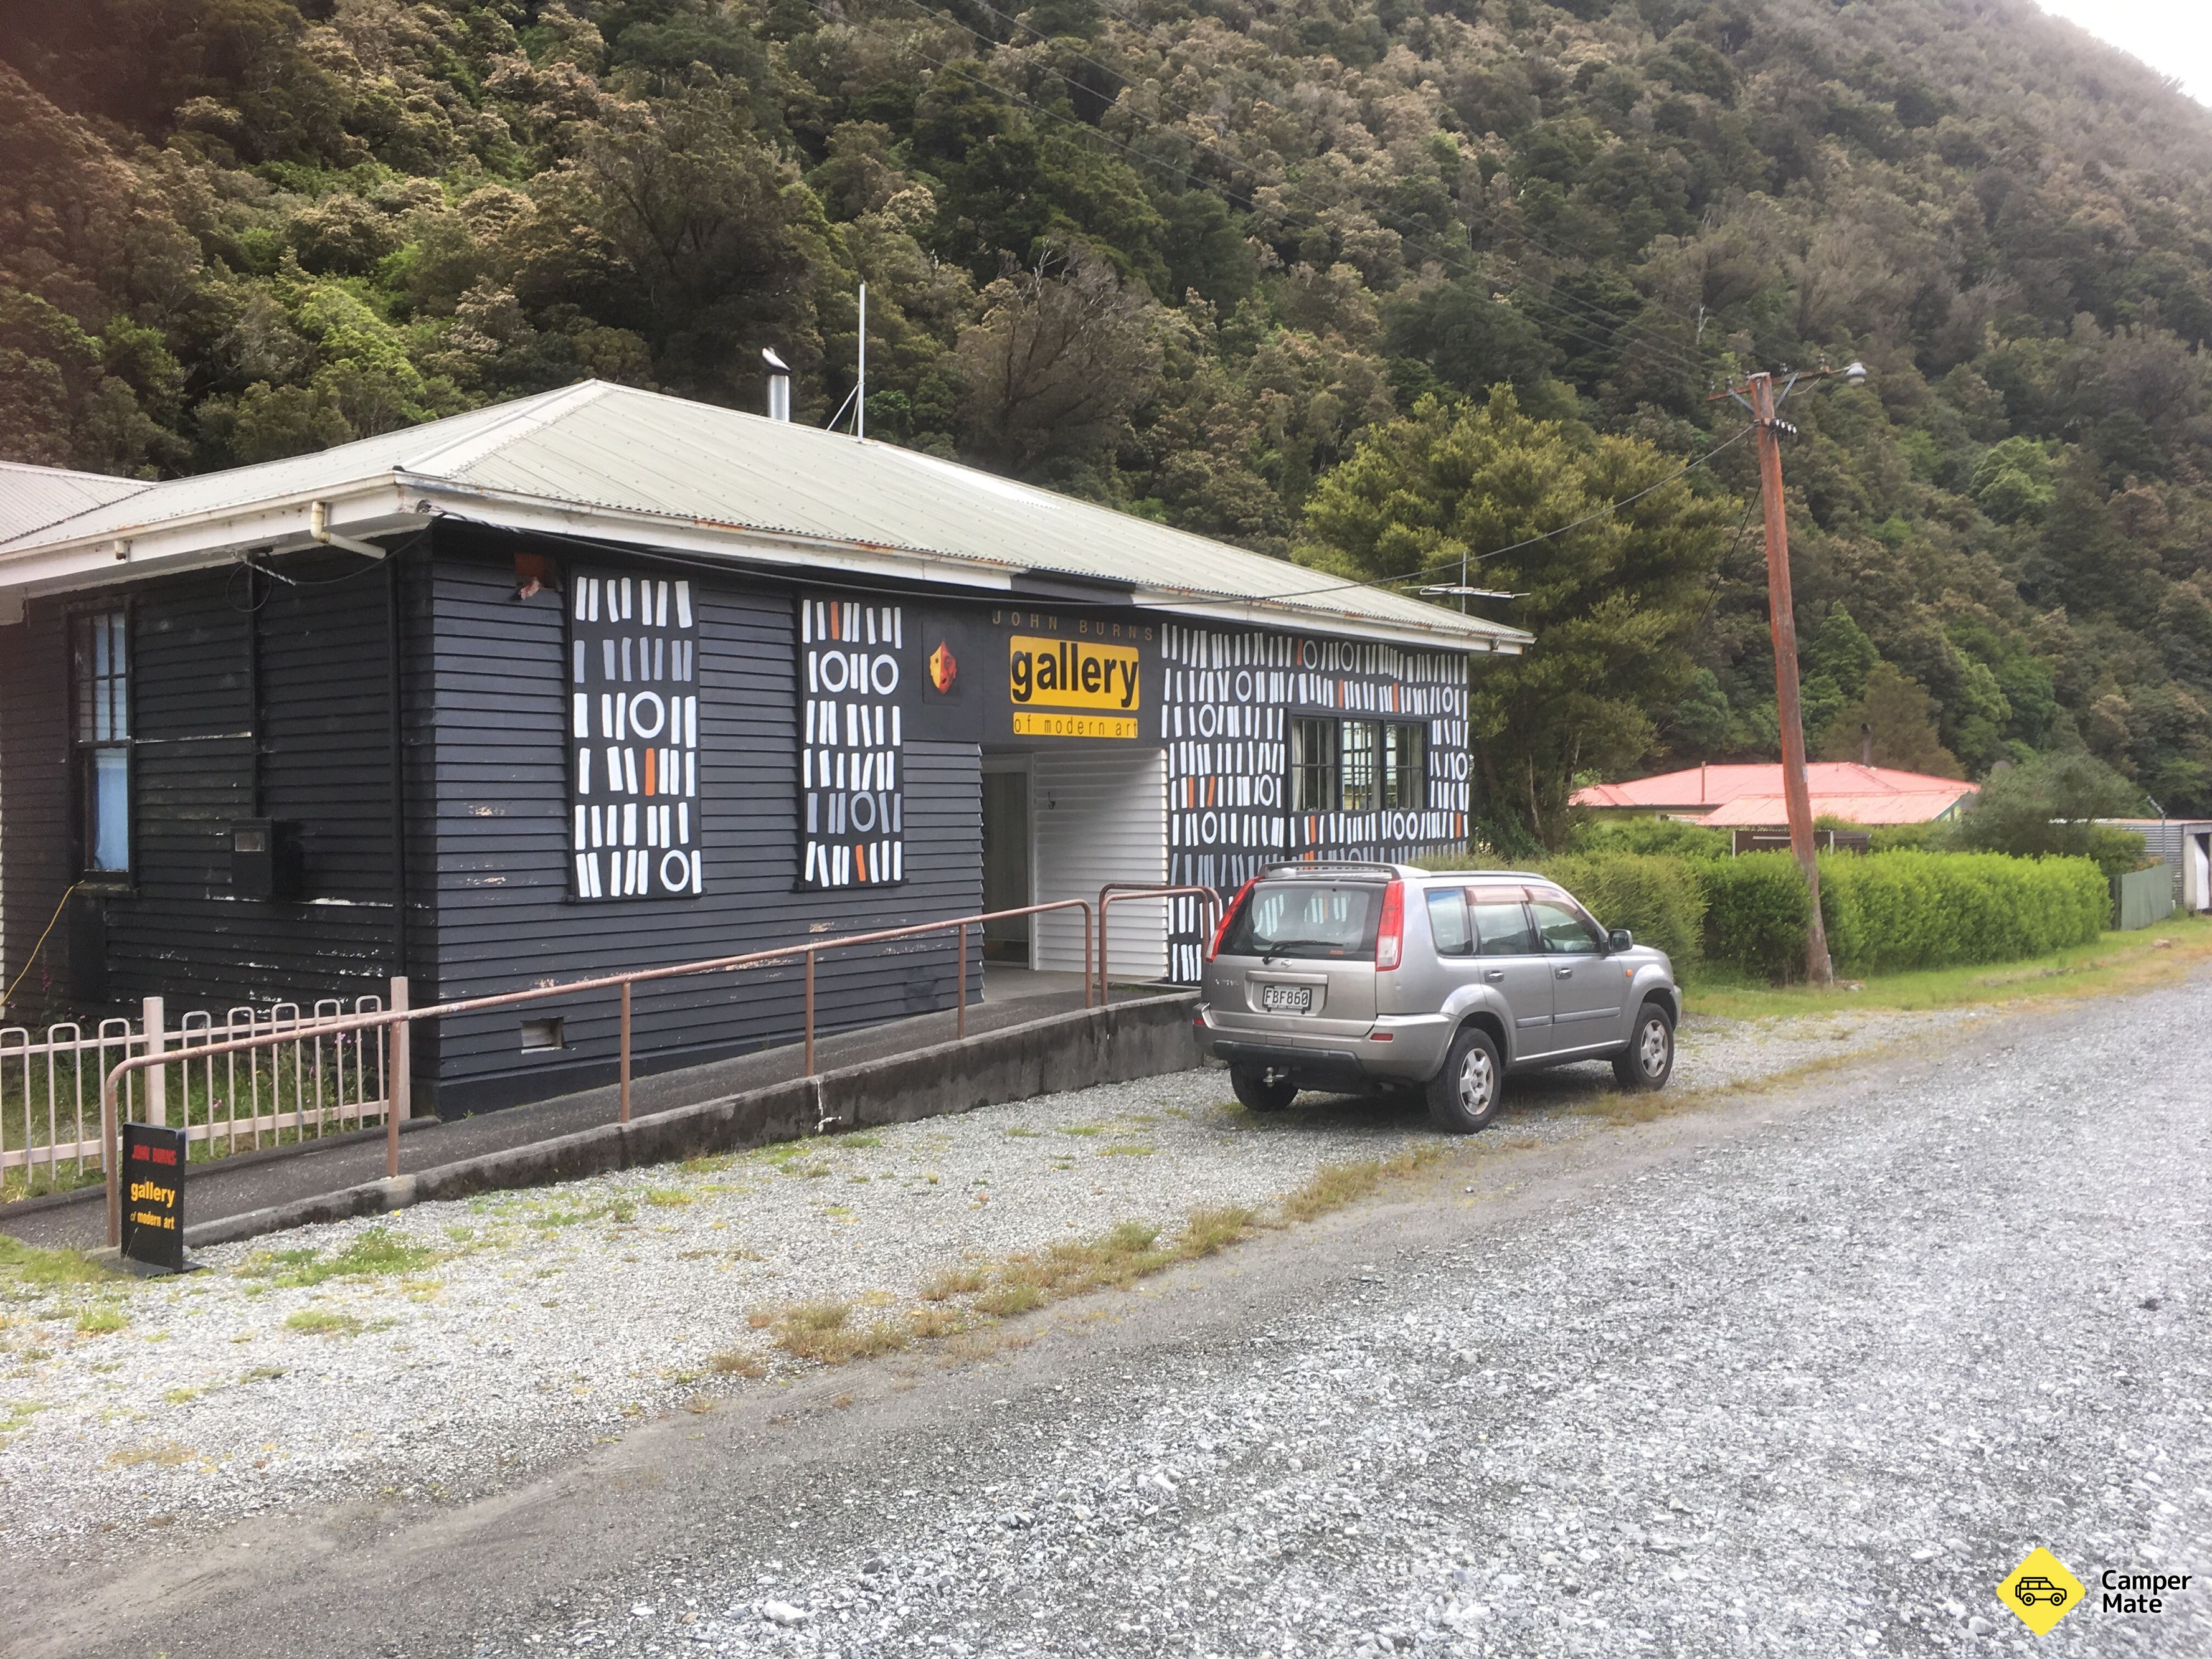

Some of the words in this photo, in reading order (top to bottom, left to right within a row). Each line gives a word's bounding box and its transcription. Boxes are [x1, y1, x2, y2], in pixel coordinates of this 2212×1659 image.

[992, 610, 1057, 630] JOHN
[1079, 620, 1153, 641] BURNS
[1011, 641, 1138, 708] gallery
[1014, 714, 1031, 732] of
[1044, 716, 1105, 735] modern
[1115, 721, 1138, 737] art
[1265, 990, 1308, 1005] FBF860
[131, 1181, 176, 1208] gallery
[130, 1211, 136, 1222] of
[137, 1211, 161, 1227] modern
[163, 1216, 175, 1230] art
